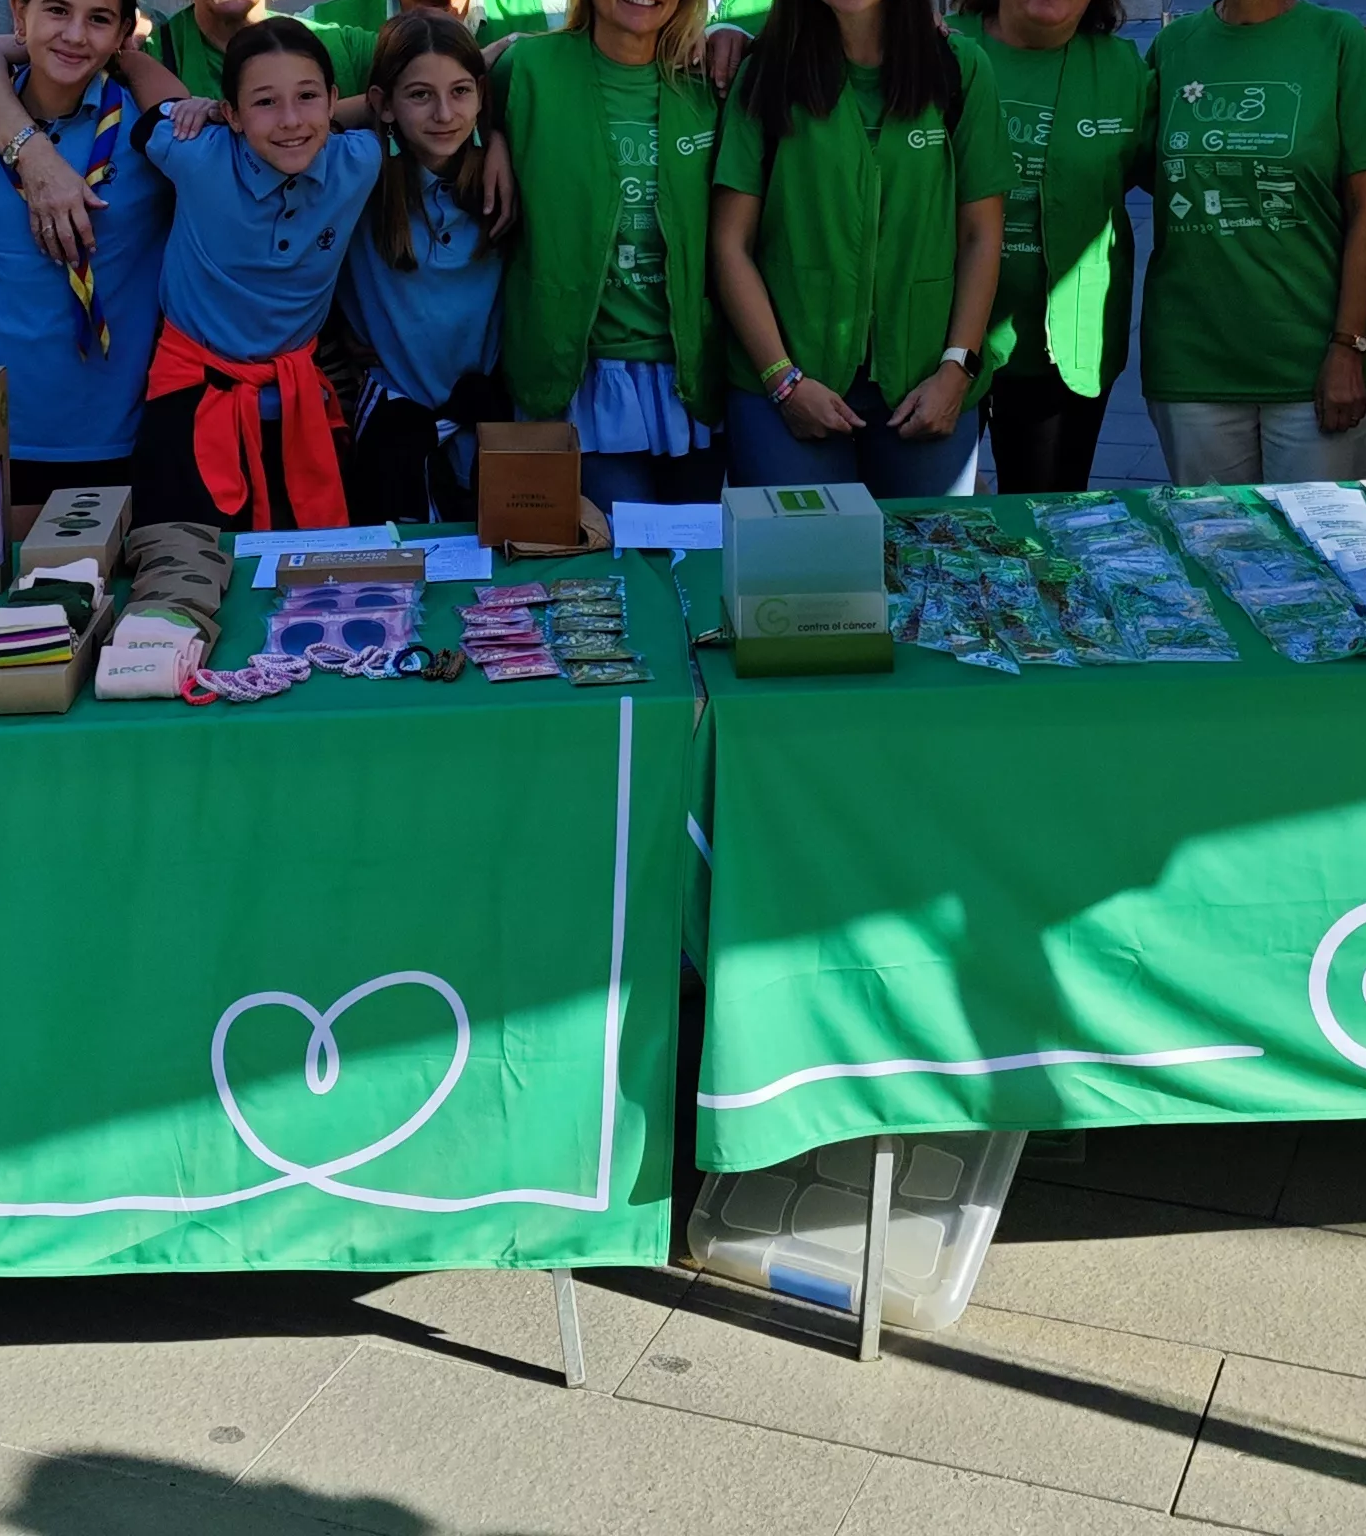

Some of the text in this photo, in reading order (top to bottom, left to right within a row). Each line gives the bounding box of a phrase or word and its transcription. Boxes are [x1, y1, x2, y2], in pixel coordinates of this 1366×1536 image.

[797, 620, 877, 632] contra el cáncer
[108, 663, 157, 676] aecc
